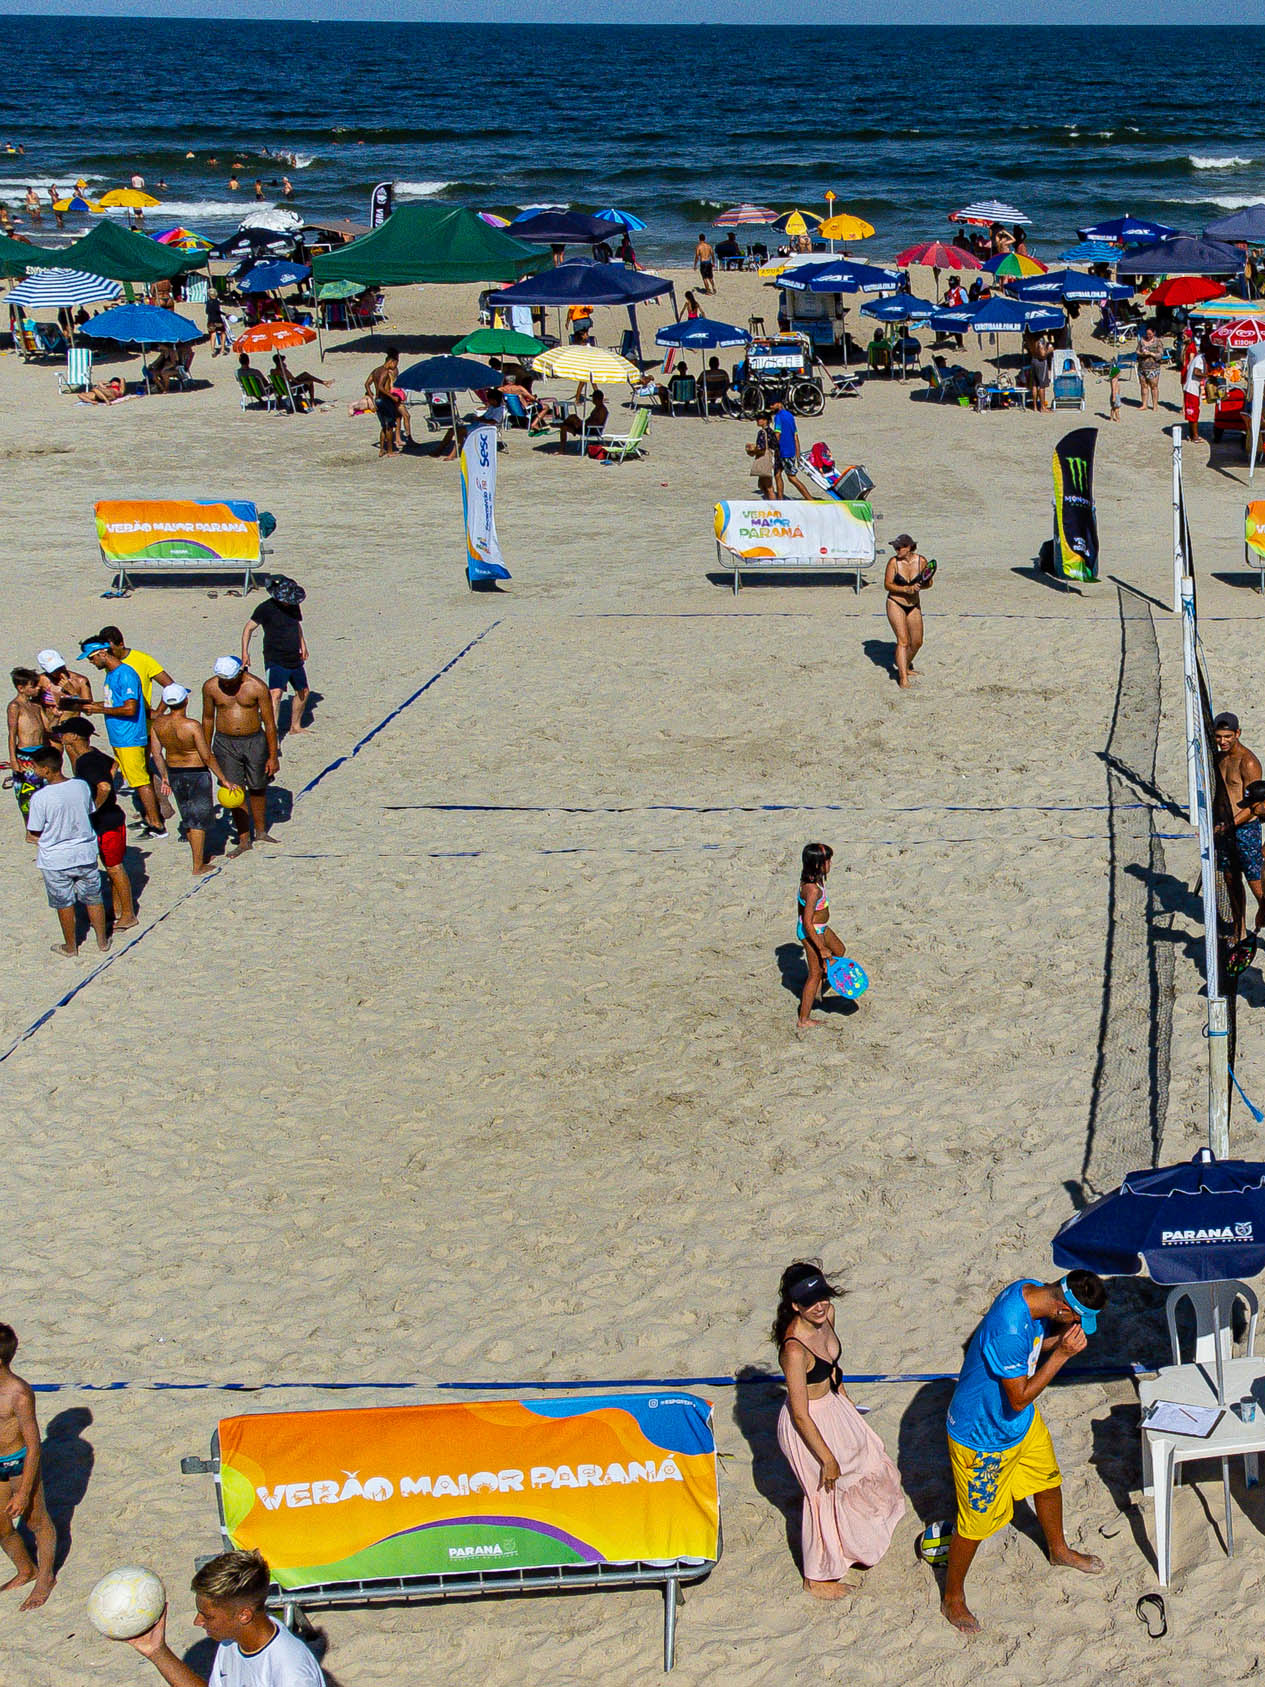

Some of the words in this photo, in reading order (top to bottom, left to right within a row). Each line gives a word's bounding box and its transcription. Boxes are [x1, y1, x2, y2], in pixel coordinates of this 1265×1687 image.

[106, 520, 152, 533] VERÃO
[153, 522, 194, 533] MAIOR
[195, 521, 248, 533] PARANÁ
[751, 518, 791, 528] MAIOR
[739, 525, 804, 539] PARANÁ
[1162, 1226, 1234, 1241] PARANÁ
[256, 1470, 395, 1511] VERÃO
[400, 1468, 525, 1499] MAIOR
[530, 1454, 684, 1490] PARANÁ
[448, 1543, 504, 1557] PARANÁ
